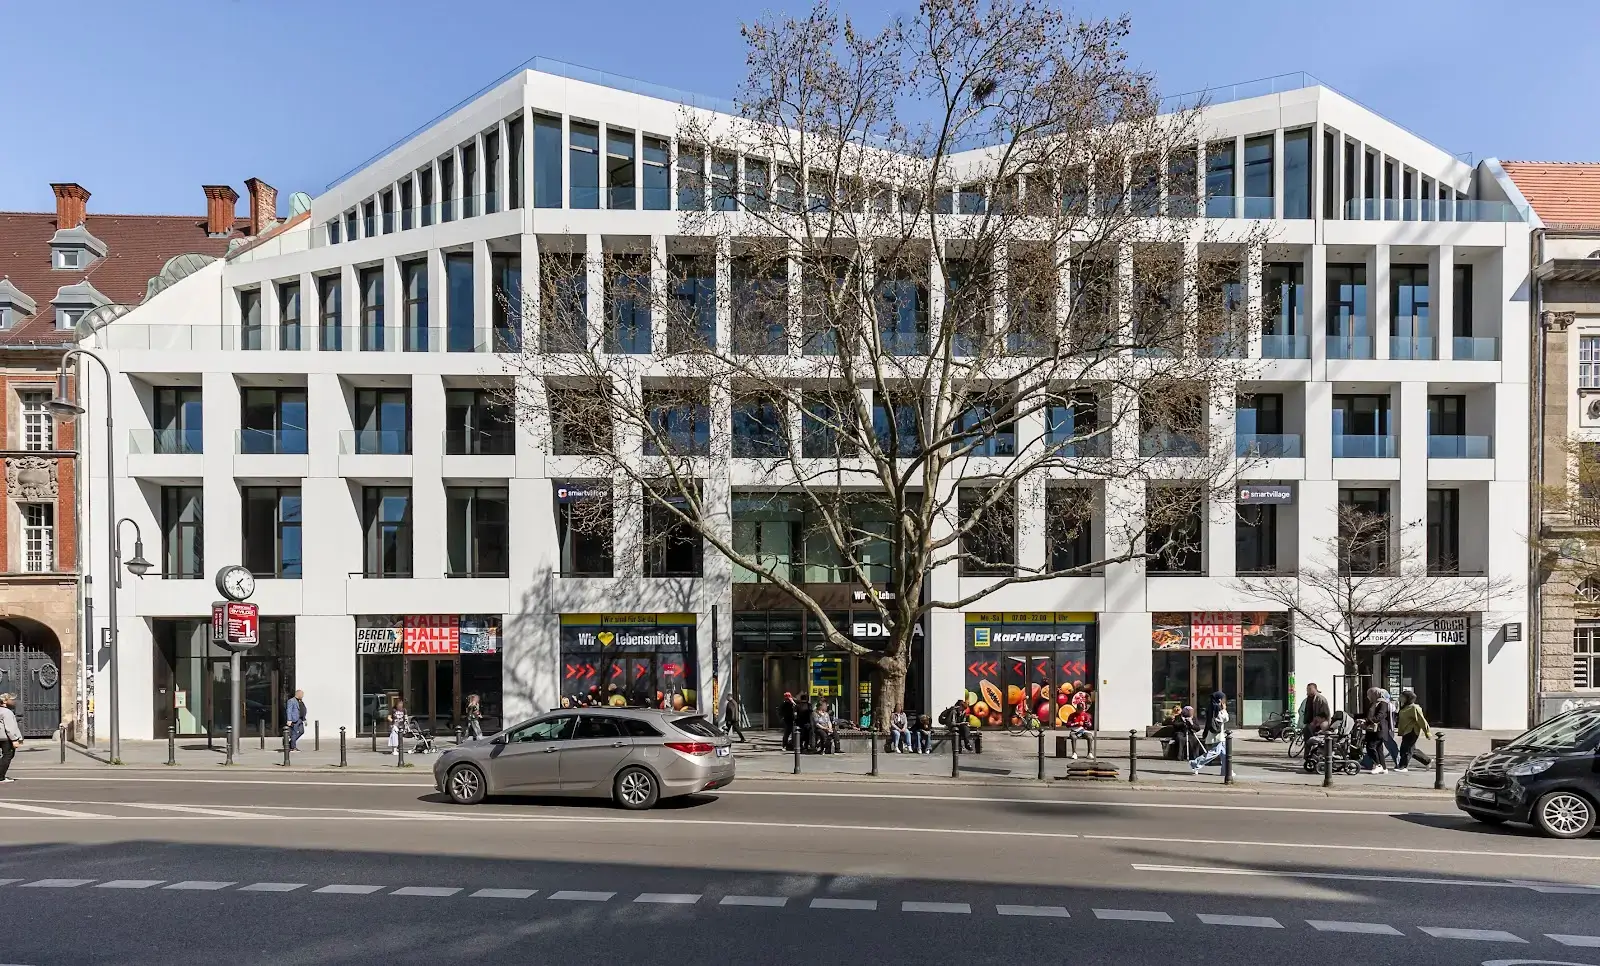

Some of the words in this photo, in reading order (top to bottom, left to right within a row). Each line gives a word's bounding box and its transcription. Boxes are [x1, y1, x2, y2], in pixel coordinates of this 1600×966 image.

[1250, 491, 1290, 499] smartvillage
[854, 591, 866, 600] Wir
[404, 616, 458, 628] KALLE
[1434, 619, 1463, 630] ROUGH
[358, 630, 393, 640] BEREIT
[404, 628, 458, 640] HALLE
[993, 632, 1084, 642] Karl-Marx-Str.
[1191, 625, 1241, 637] HALLE
[579, 633, 596, 645] Wir
[615, 633, 681, 646] Lebensmittel.
[1191, 637, 1241, 649] KALLE
[1435, 632, 1464, 643] TRADE
[357, 641, 376, 653] FÜR
[404, 641, 458, 653] KALLE
